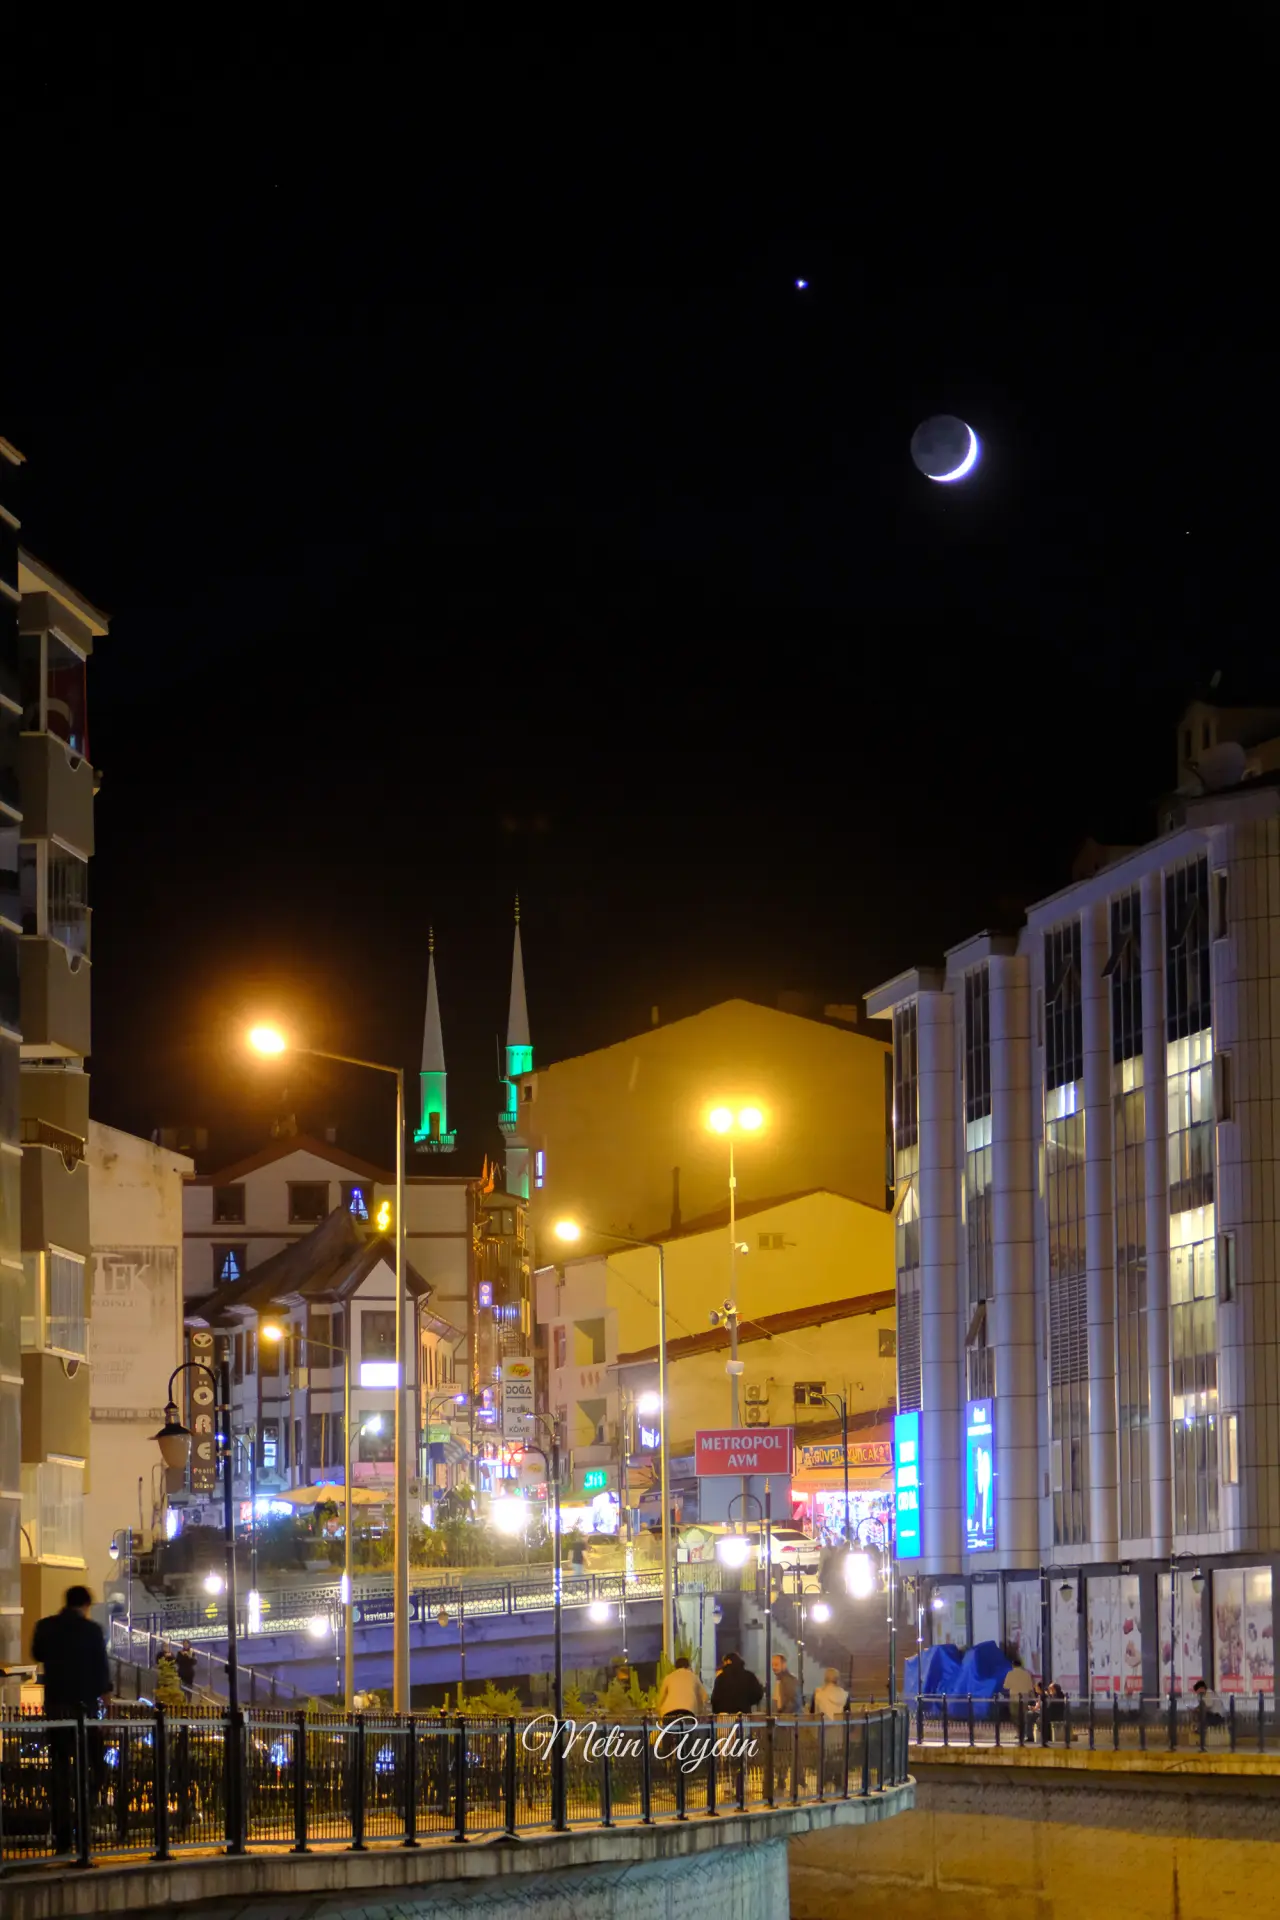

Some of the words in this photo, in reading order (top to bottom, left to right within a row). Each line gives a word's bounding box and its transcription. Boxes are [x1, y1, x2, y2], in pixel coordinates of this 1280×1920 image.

[506, 1384, 532, 1395] DOĞA
[509, 1425, 530, 1433] KÖME
[701, 1435, 783, 1451] METROPOL
[727, 1453, 759, 1468] AVM
[843, 1446, 880, 1463] YUNCAK
